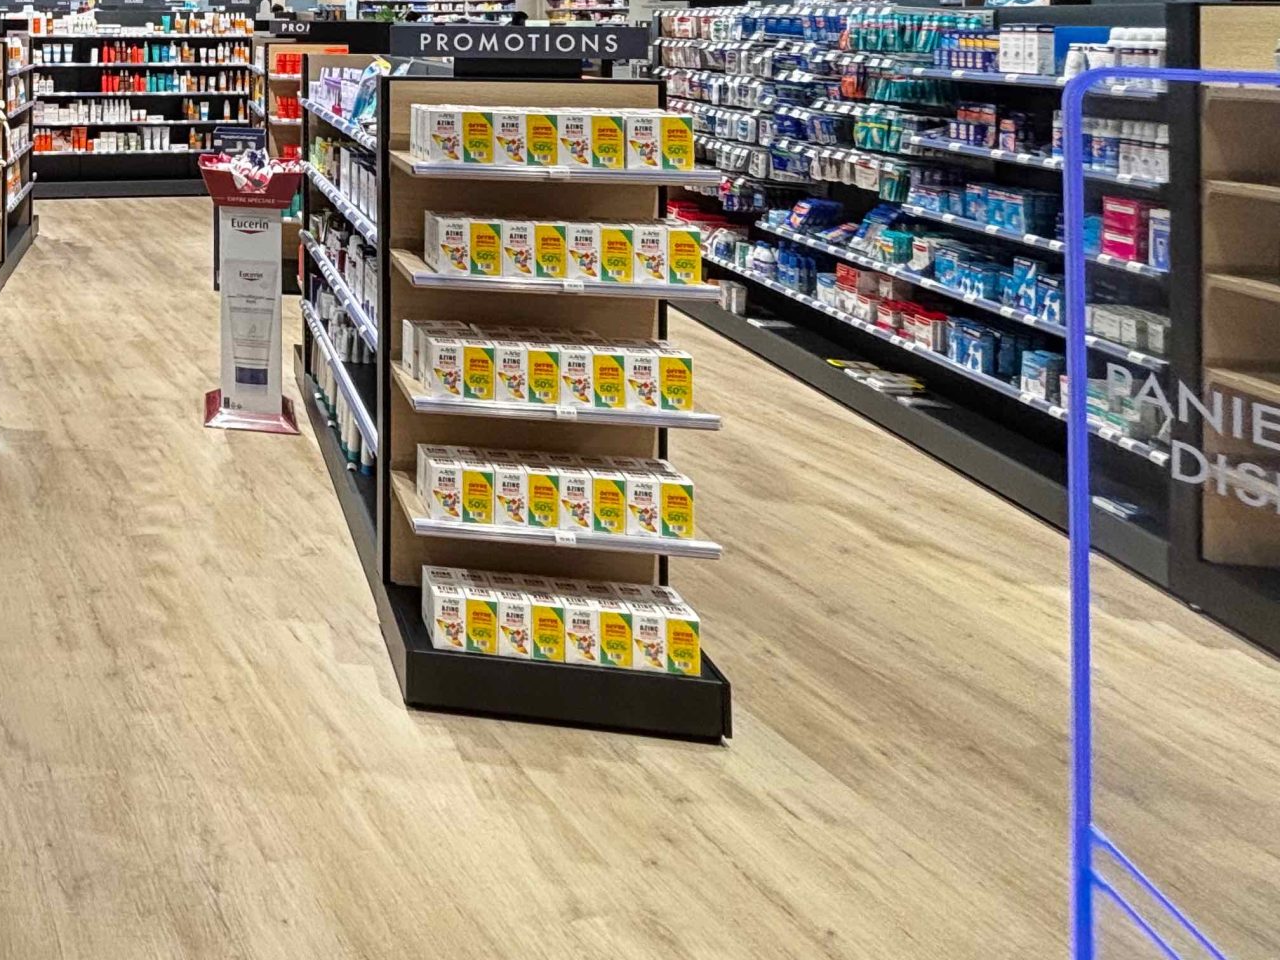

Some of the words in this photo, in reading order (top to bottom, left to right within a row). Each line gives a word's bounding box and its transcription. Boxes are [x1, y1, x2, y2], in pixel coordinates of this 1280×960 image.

[420, 33, 618, 53] PROMOTIONS
[231, 218, 269, 230] Eucerin
[239, 270, 264, 278] Eucerin
[1171, 440, 1280, 514] DIS
